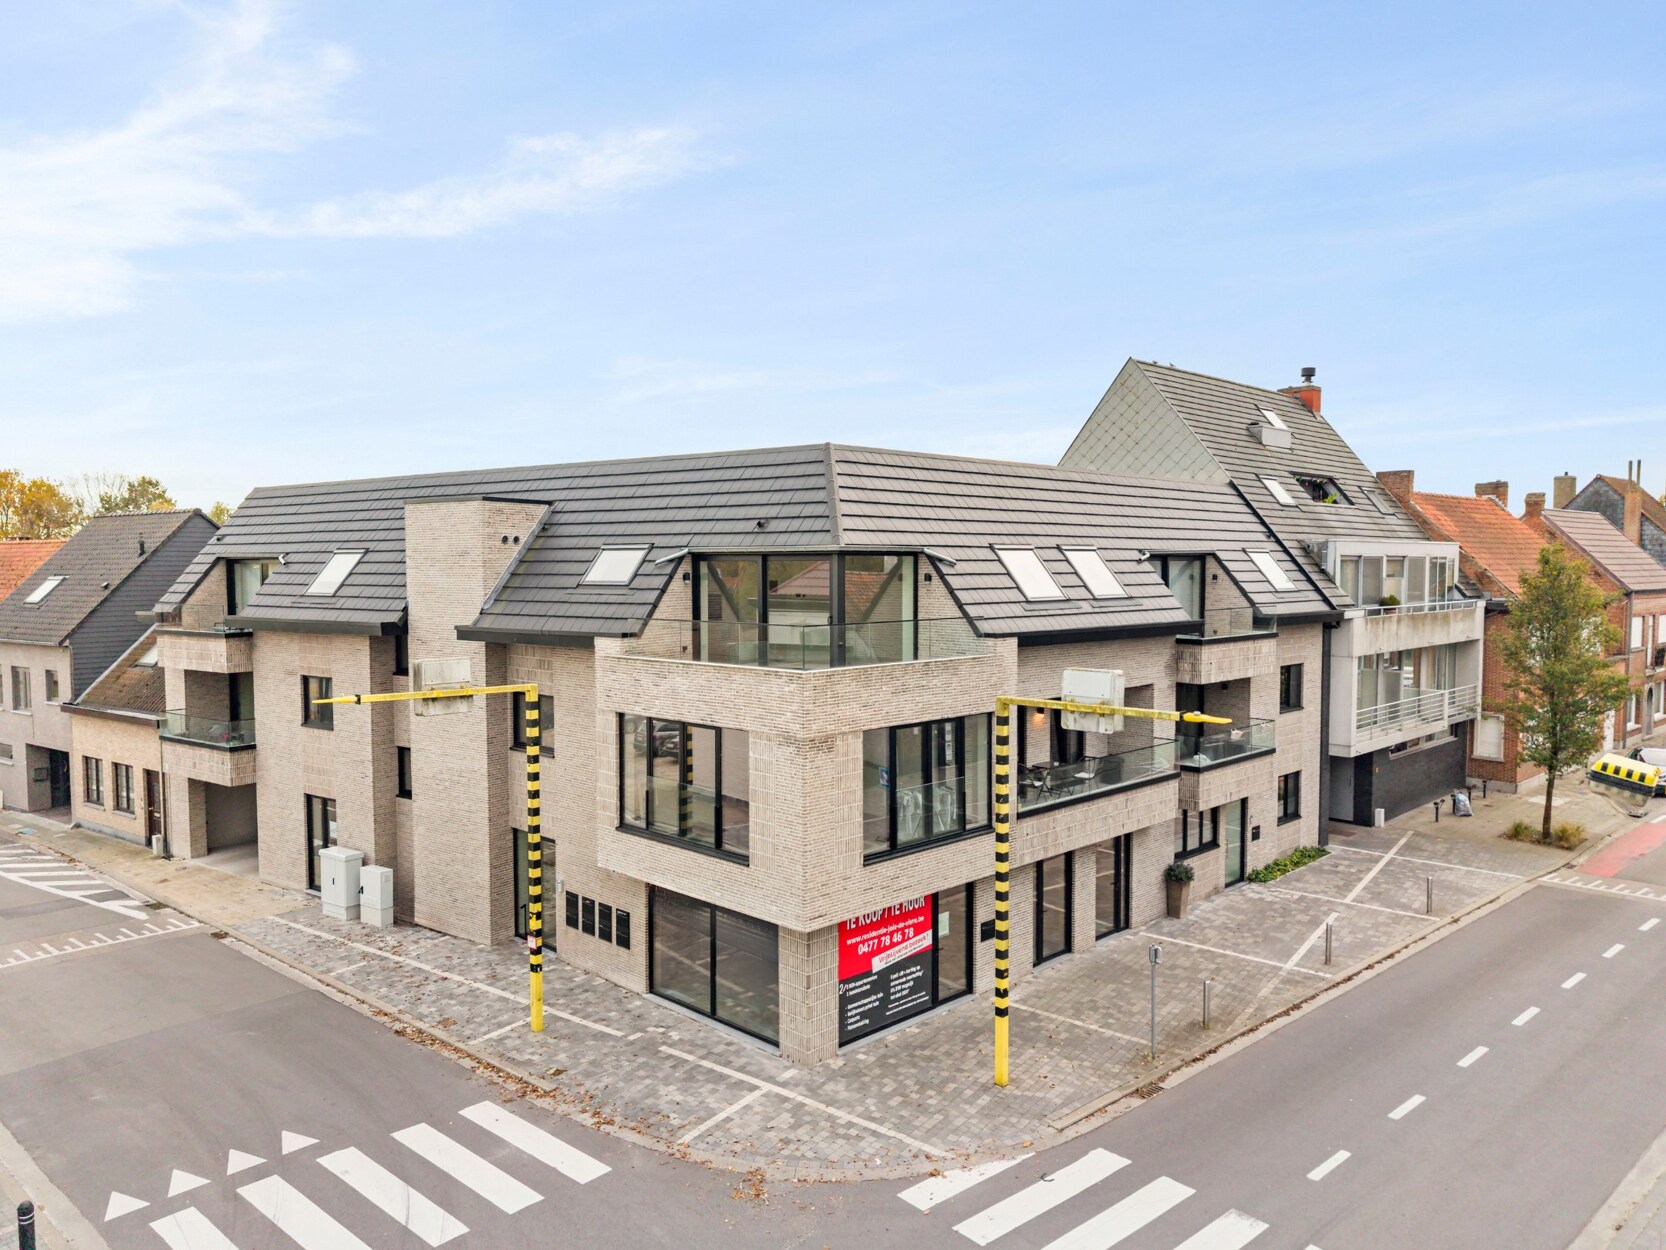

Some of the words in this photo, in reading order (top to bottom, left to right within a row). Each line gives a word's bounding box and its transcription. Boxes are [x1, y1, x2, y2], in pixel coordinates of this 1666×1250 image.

[846, 916, 925, 945] www.residentie-joie-de-vivre.be
[858, 939, 878, 955] 0477
[880, 935, 890, 948] 78
[892, 931, 902, 943] 46
[904, 927, 914, 940] 78
